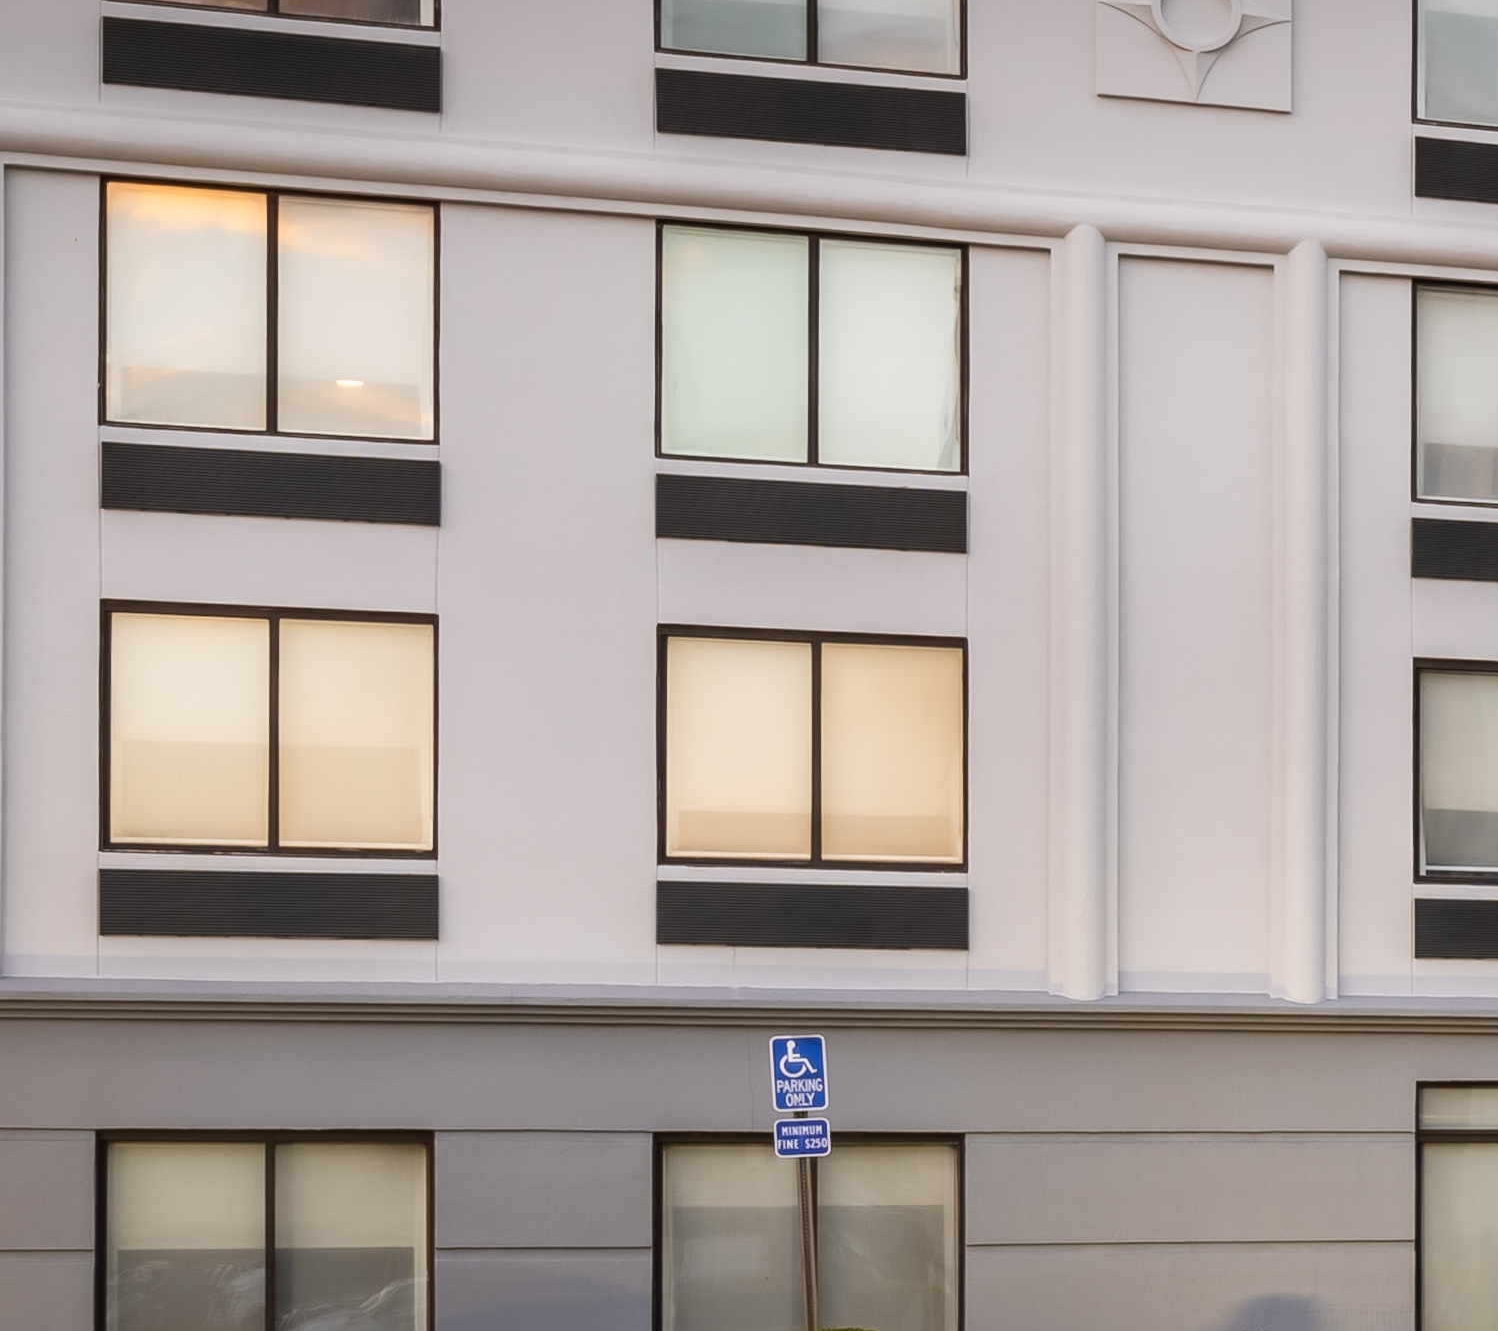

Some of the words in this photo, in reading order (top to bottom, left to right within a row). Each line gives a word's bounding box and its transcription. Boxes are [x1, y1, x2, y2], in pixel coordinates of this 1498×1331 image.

[776, 1078, 823, 1093] PARKING
[785, 1093, 816, 1107] ONLY
[781, 1125, 823, 1136] MINIMUM
[777, 1138, 799, 1149] FINE
[804, 1137, 828, 1149] $250
